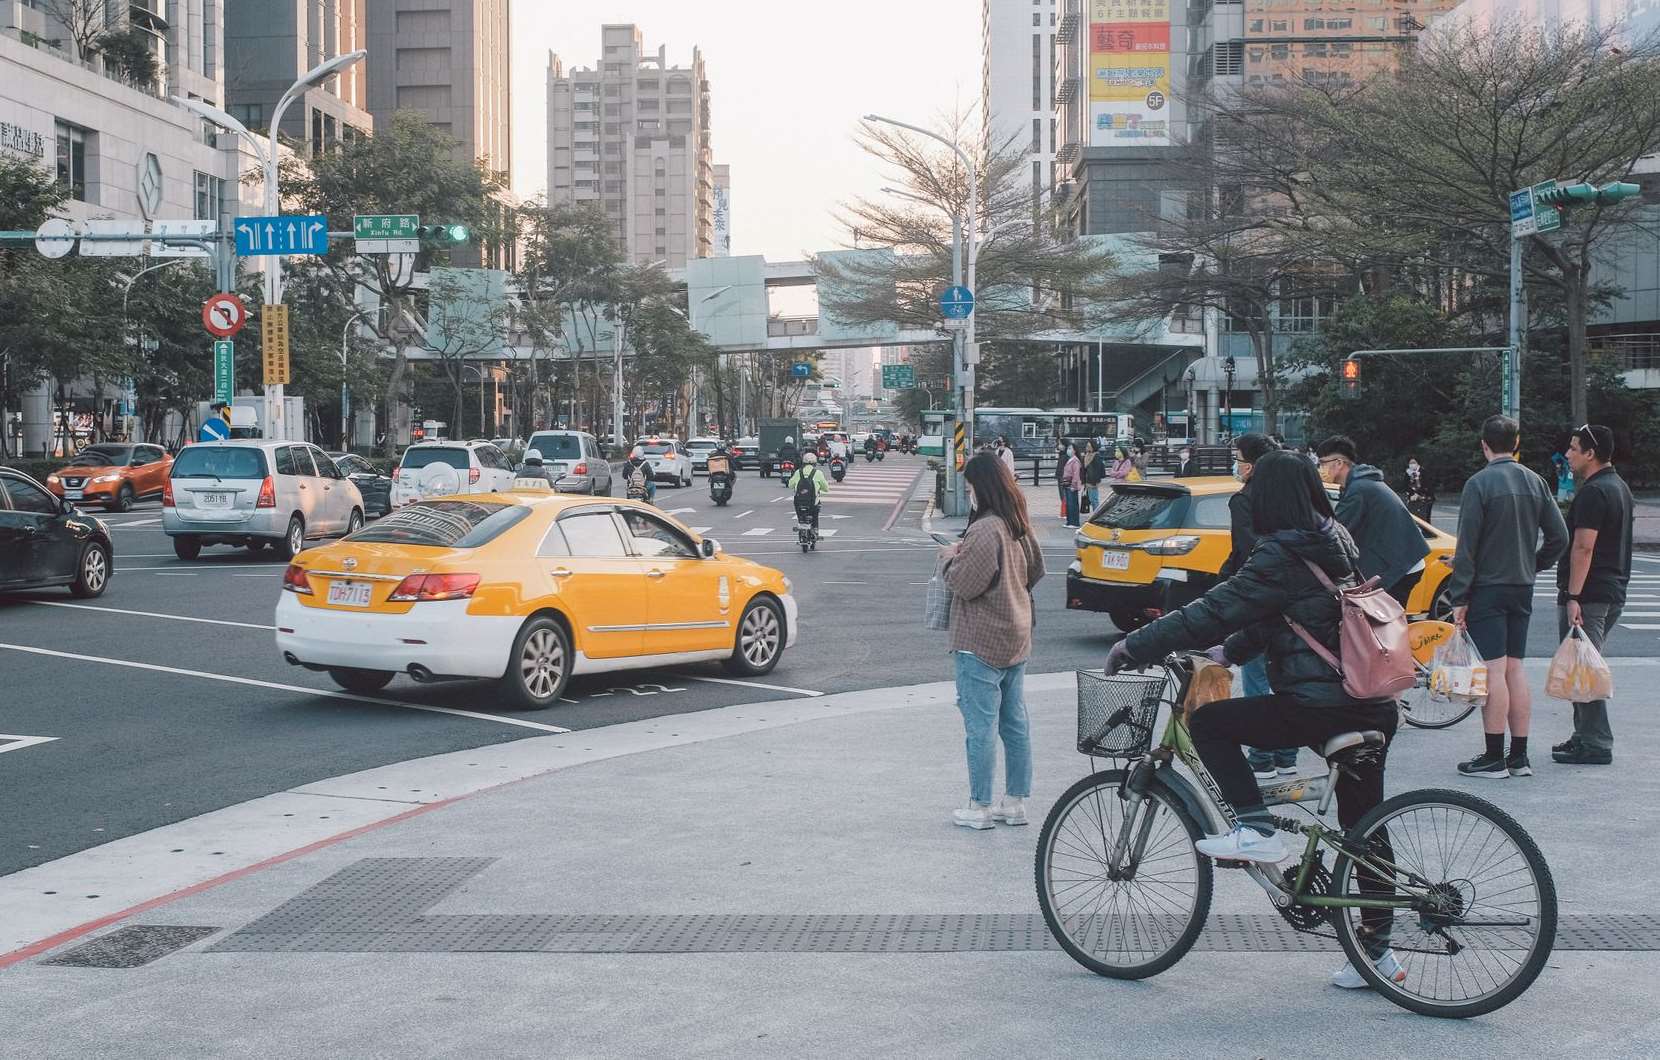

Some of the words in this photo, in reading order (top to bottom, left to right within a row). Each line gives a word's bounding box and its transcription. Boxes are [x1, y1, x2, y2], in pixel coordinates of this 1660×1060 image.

[1148, 95, 1163, 107] 5F
[362, 217, 410, 229] 新府路
